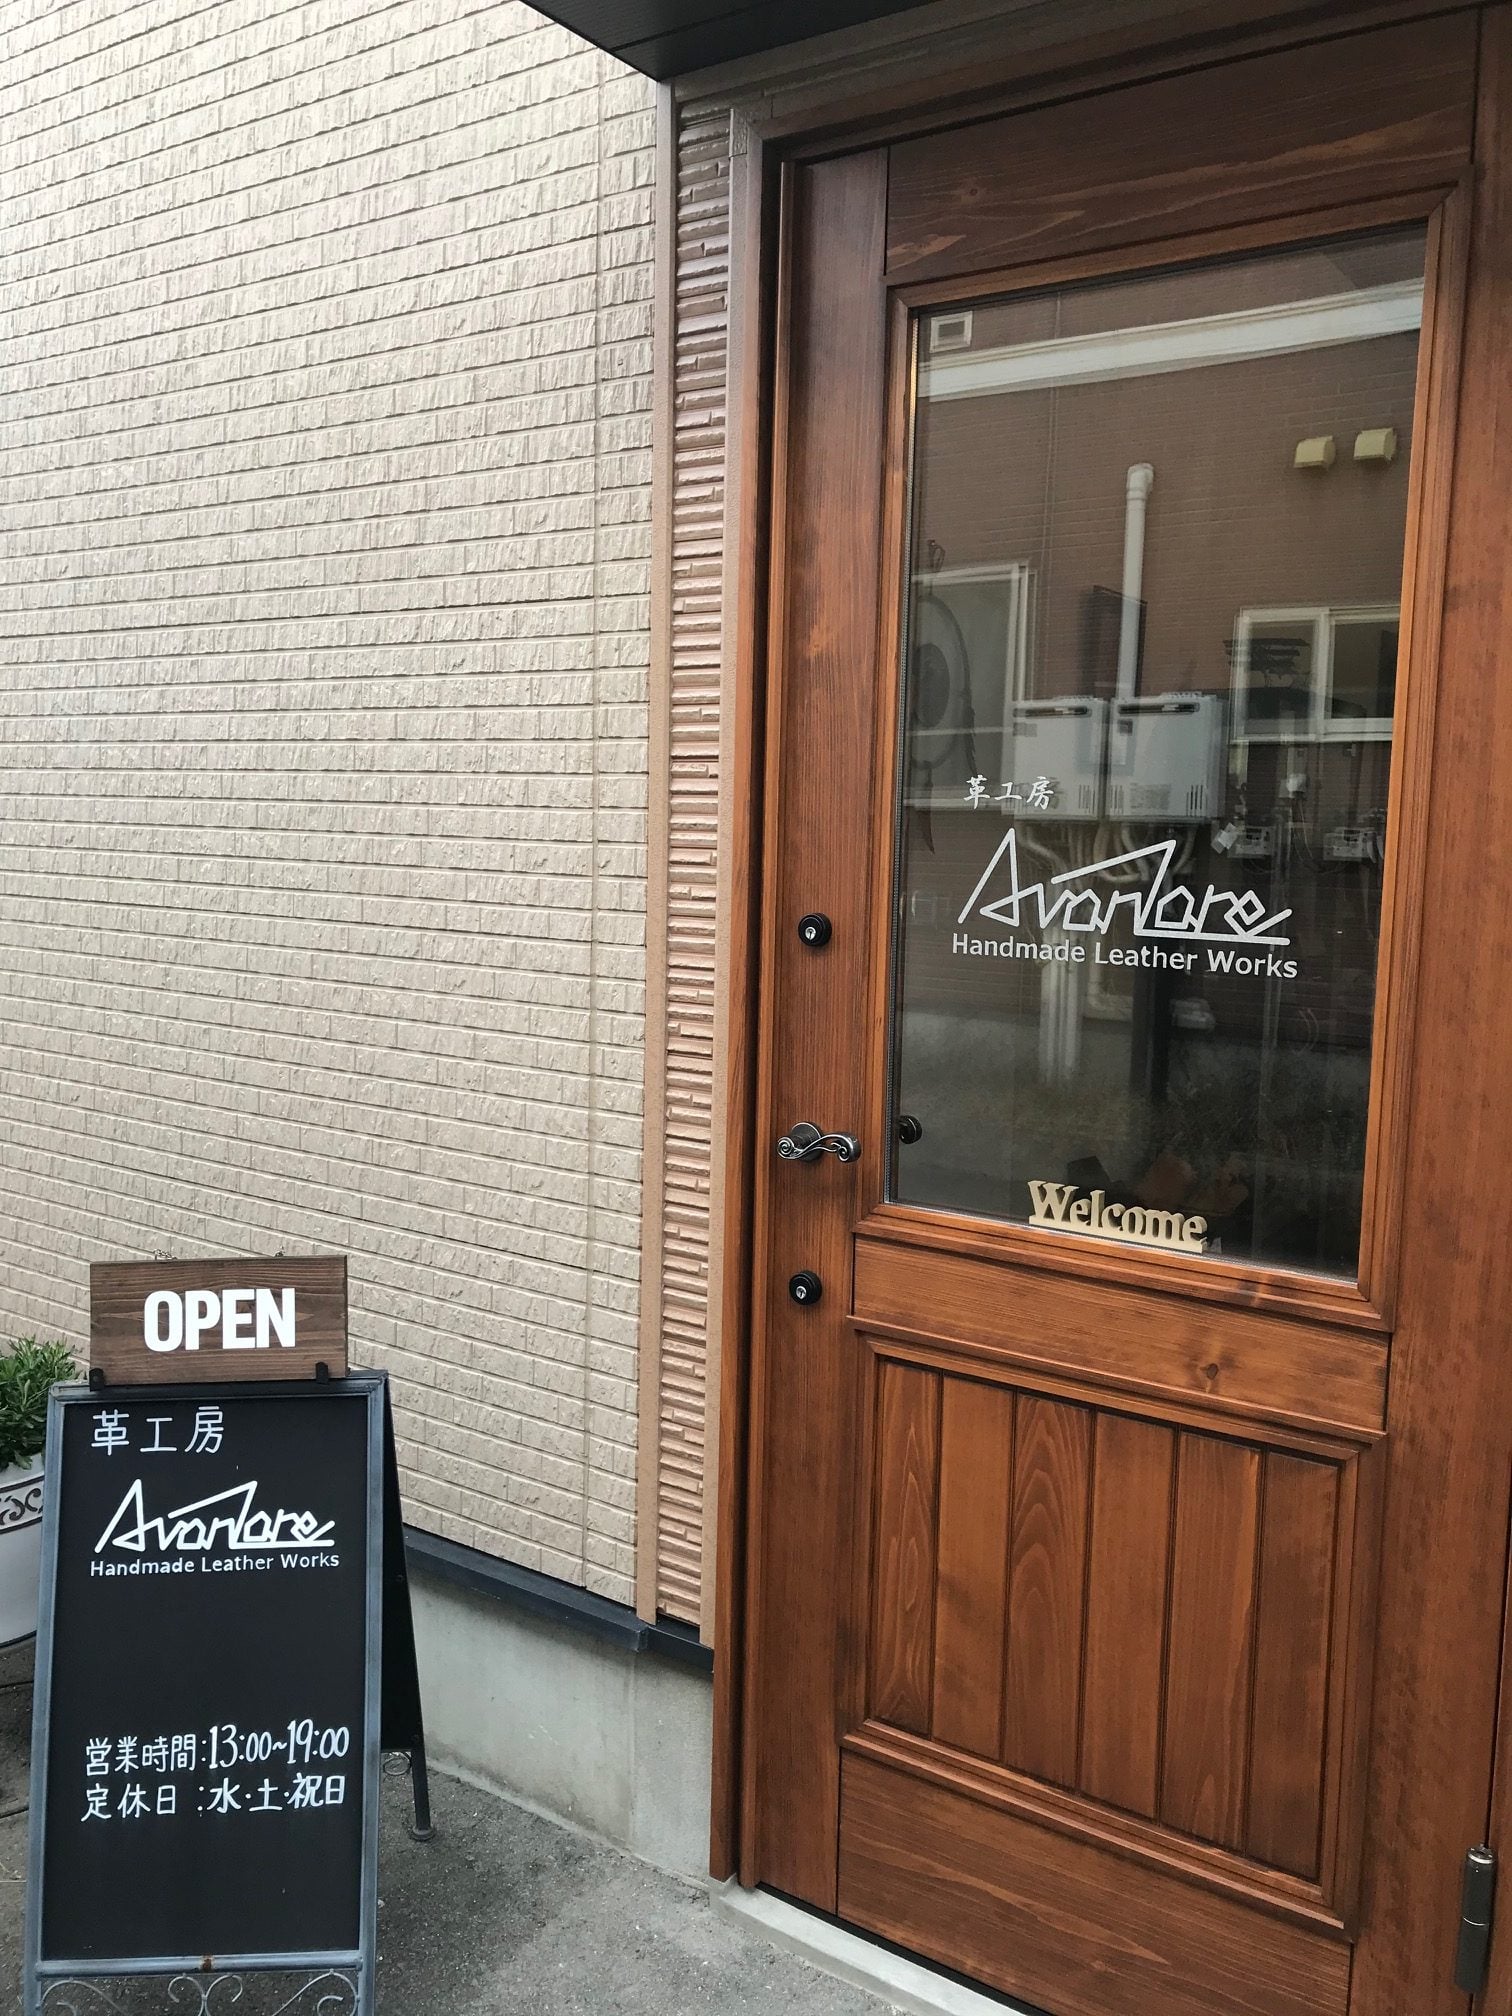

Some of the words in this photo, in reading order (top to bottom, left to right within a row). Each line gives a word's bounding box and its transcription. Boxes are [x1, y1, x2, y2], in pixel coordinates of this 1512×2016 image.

[963, 774, 1054, 810] 革工房
[953, 933, 1085, 963] Handmade
[1094, 942, 1198, 971] Leather
[1207, 949, 1298, 979] Works
[1027, 1180, 1208, 1253] Welcome
[144, 1287, 296, 1352] OPEN
[91, 1405, 224, 1456] 革工房
[90, 1557, 195, 1577] Handmade
[201, 1553, 273, 1573] Leather
[280, 1551, 340, 1569] Works
